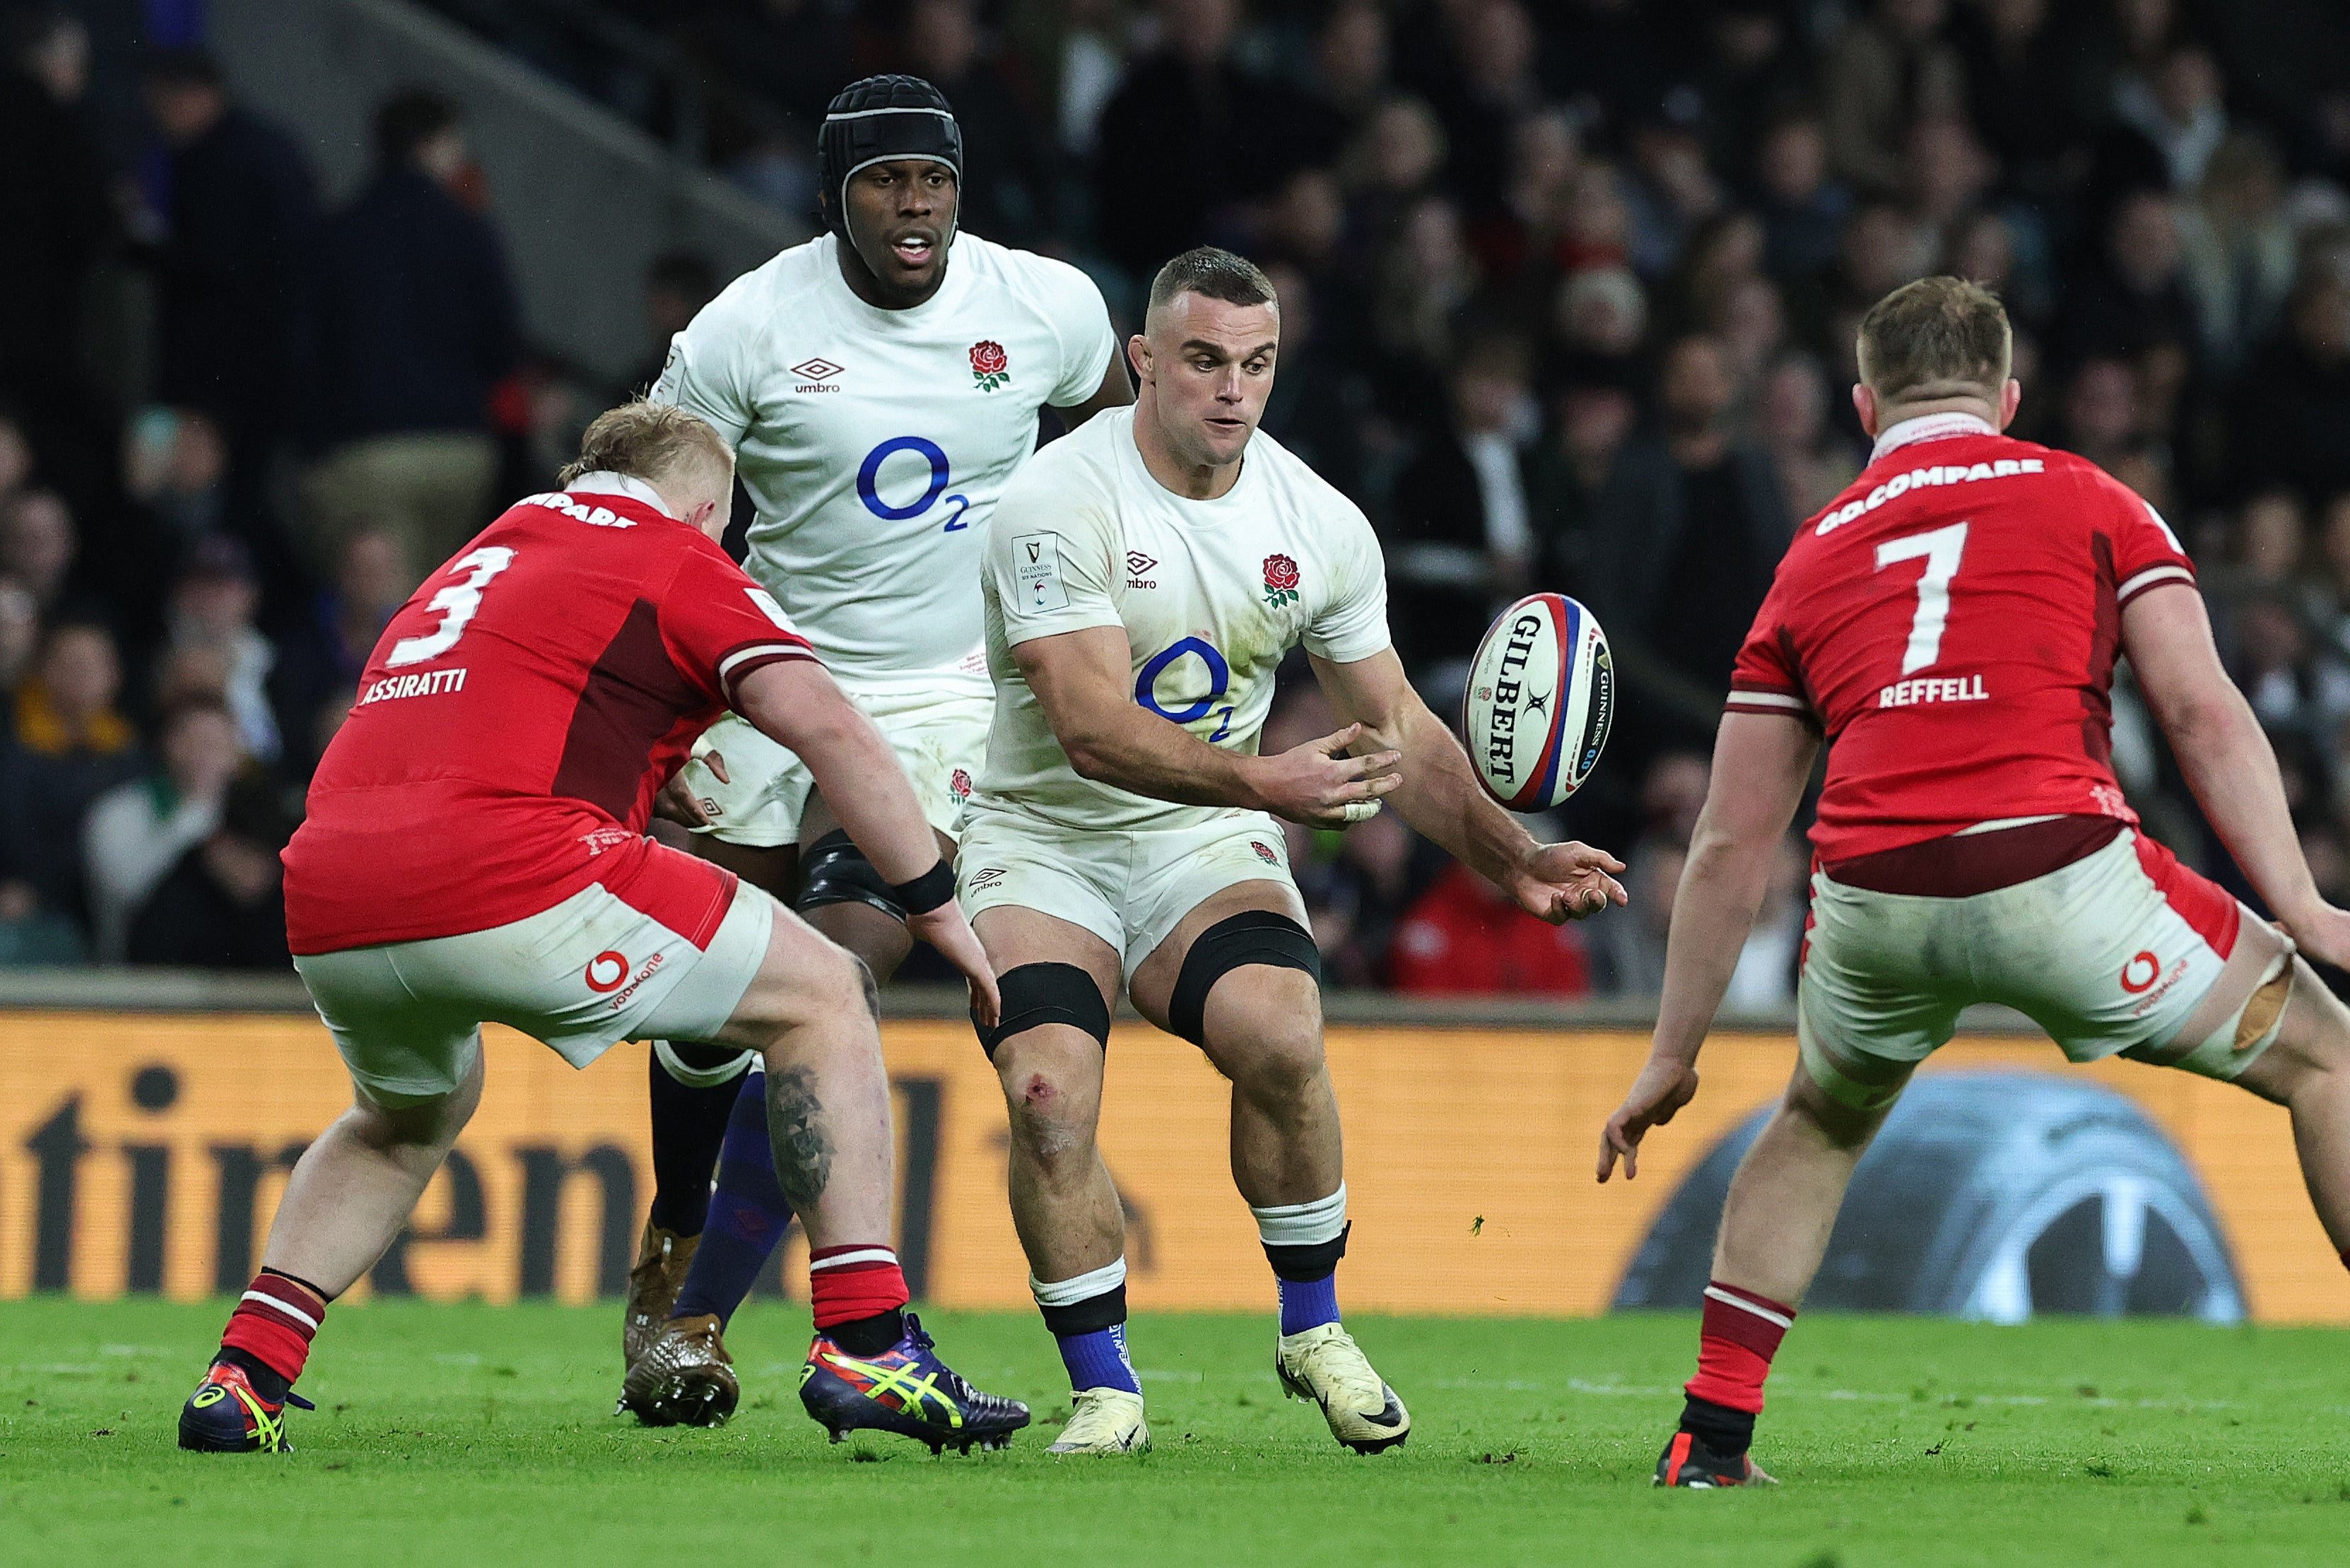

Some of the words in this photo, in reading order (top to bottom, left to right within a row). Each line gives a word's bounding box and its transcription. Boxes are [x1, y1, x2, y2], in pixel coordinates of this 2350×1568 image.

[794, 382, 840, 394] umbro
[1020, 564, 1052, 574] GUINNESS
[1126, 577, 1157, 589] mbro
[385, 545, 520, 669] 3
[1874, 519, 1970, 677] 7
[358, 668, 468, 707] ASSIRATTI
[1489, 615, 1541, 784] GILBERT
[1879, 674, 1990, 709] REFFELL
[1592, 671, 1610, 746] GUINNESS
[1581, 749, 1597, 770] 0.0
[970, 881, 1003, 898] umbro
